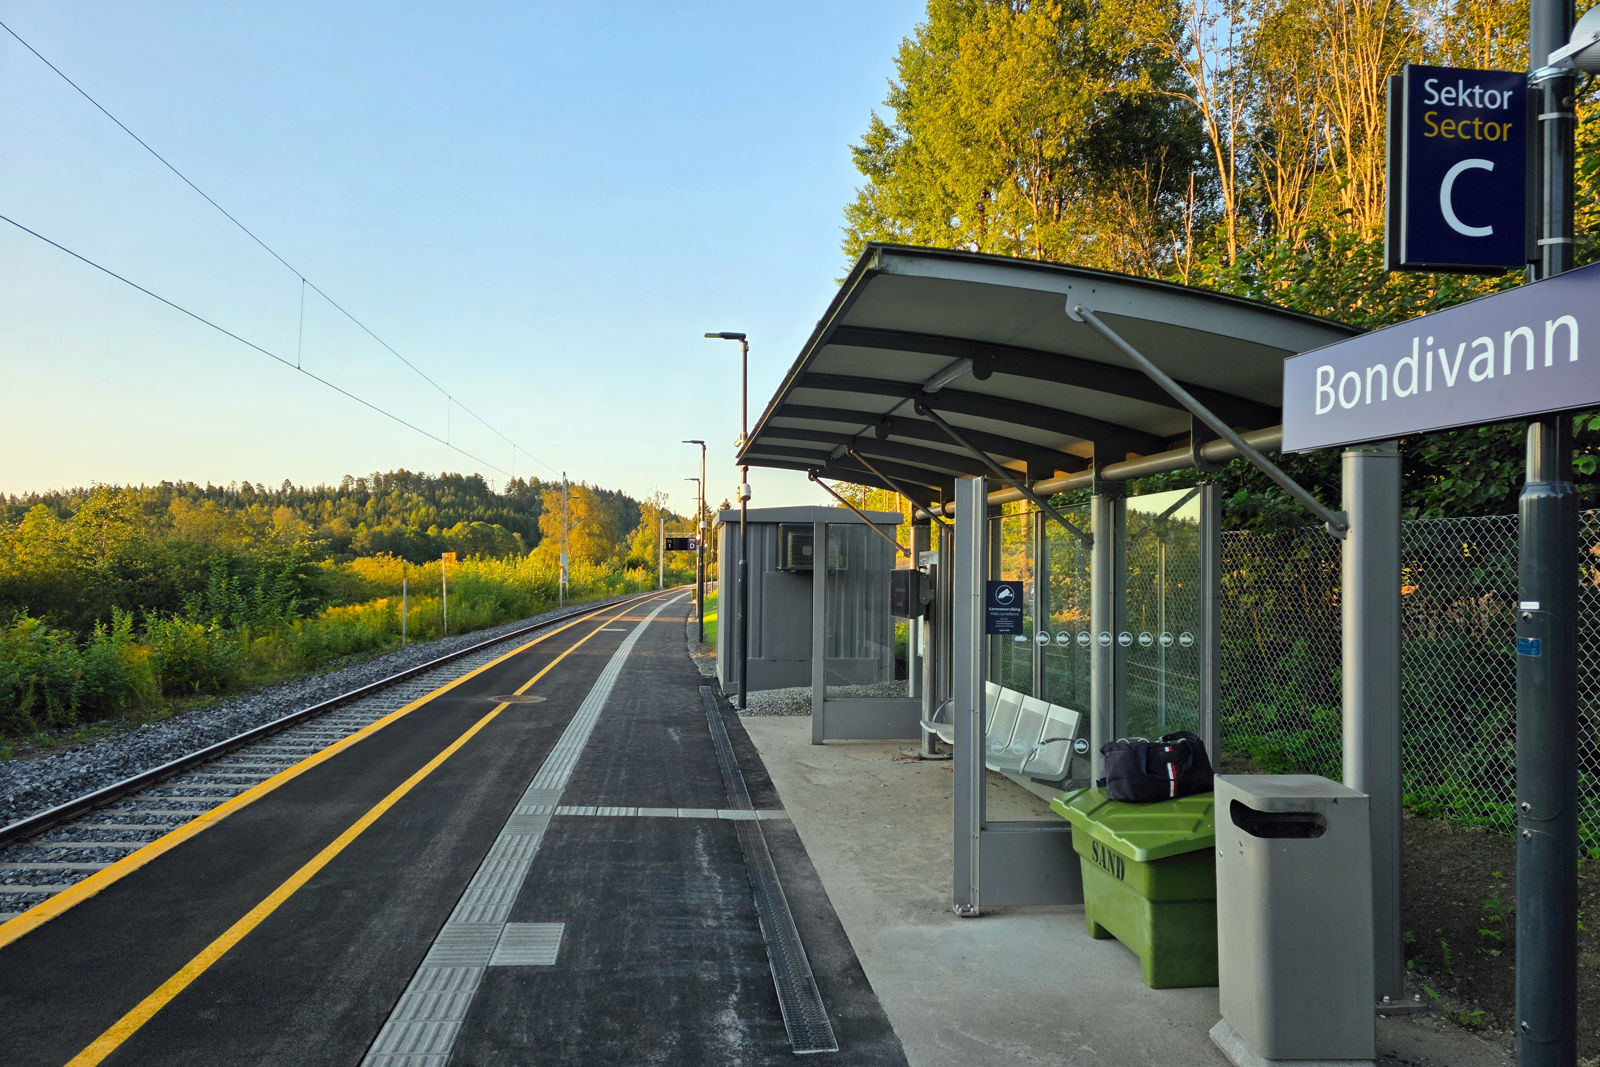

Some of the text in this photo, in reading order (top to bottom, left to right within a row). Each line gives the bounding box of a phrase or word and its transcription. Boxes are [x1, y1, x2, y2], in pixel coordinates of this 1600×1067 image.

[1423, 78, 1513, 110] Sektor
[1423, 111, 1513, 142] Sector
[1439, 158, 1495, 238] C
[1315, 314, 1580, 415] Bondivann
[1092, 840, 1126, 881] SAND
